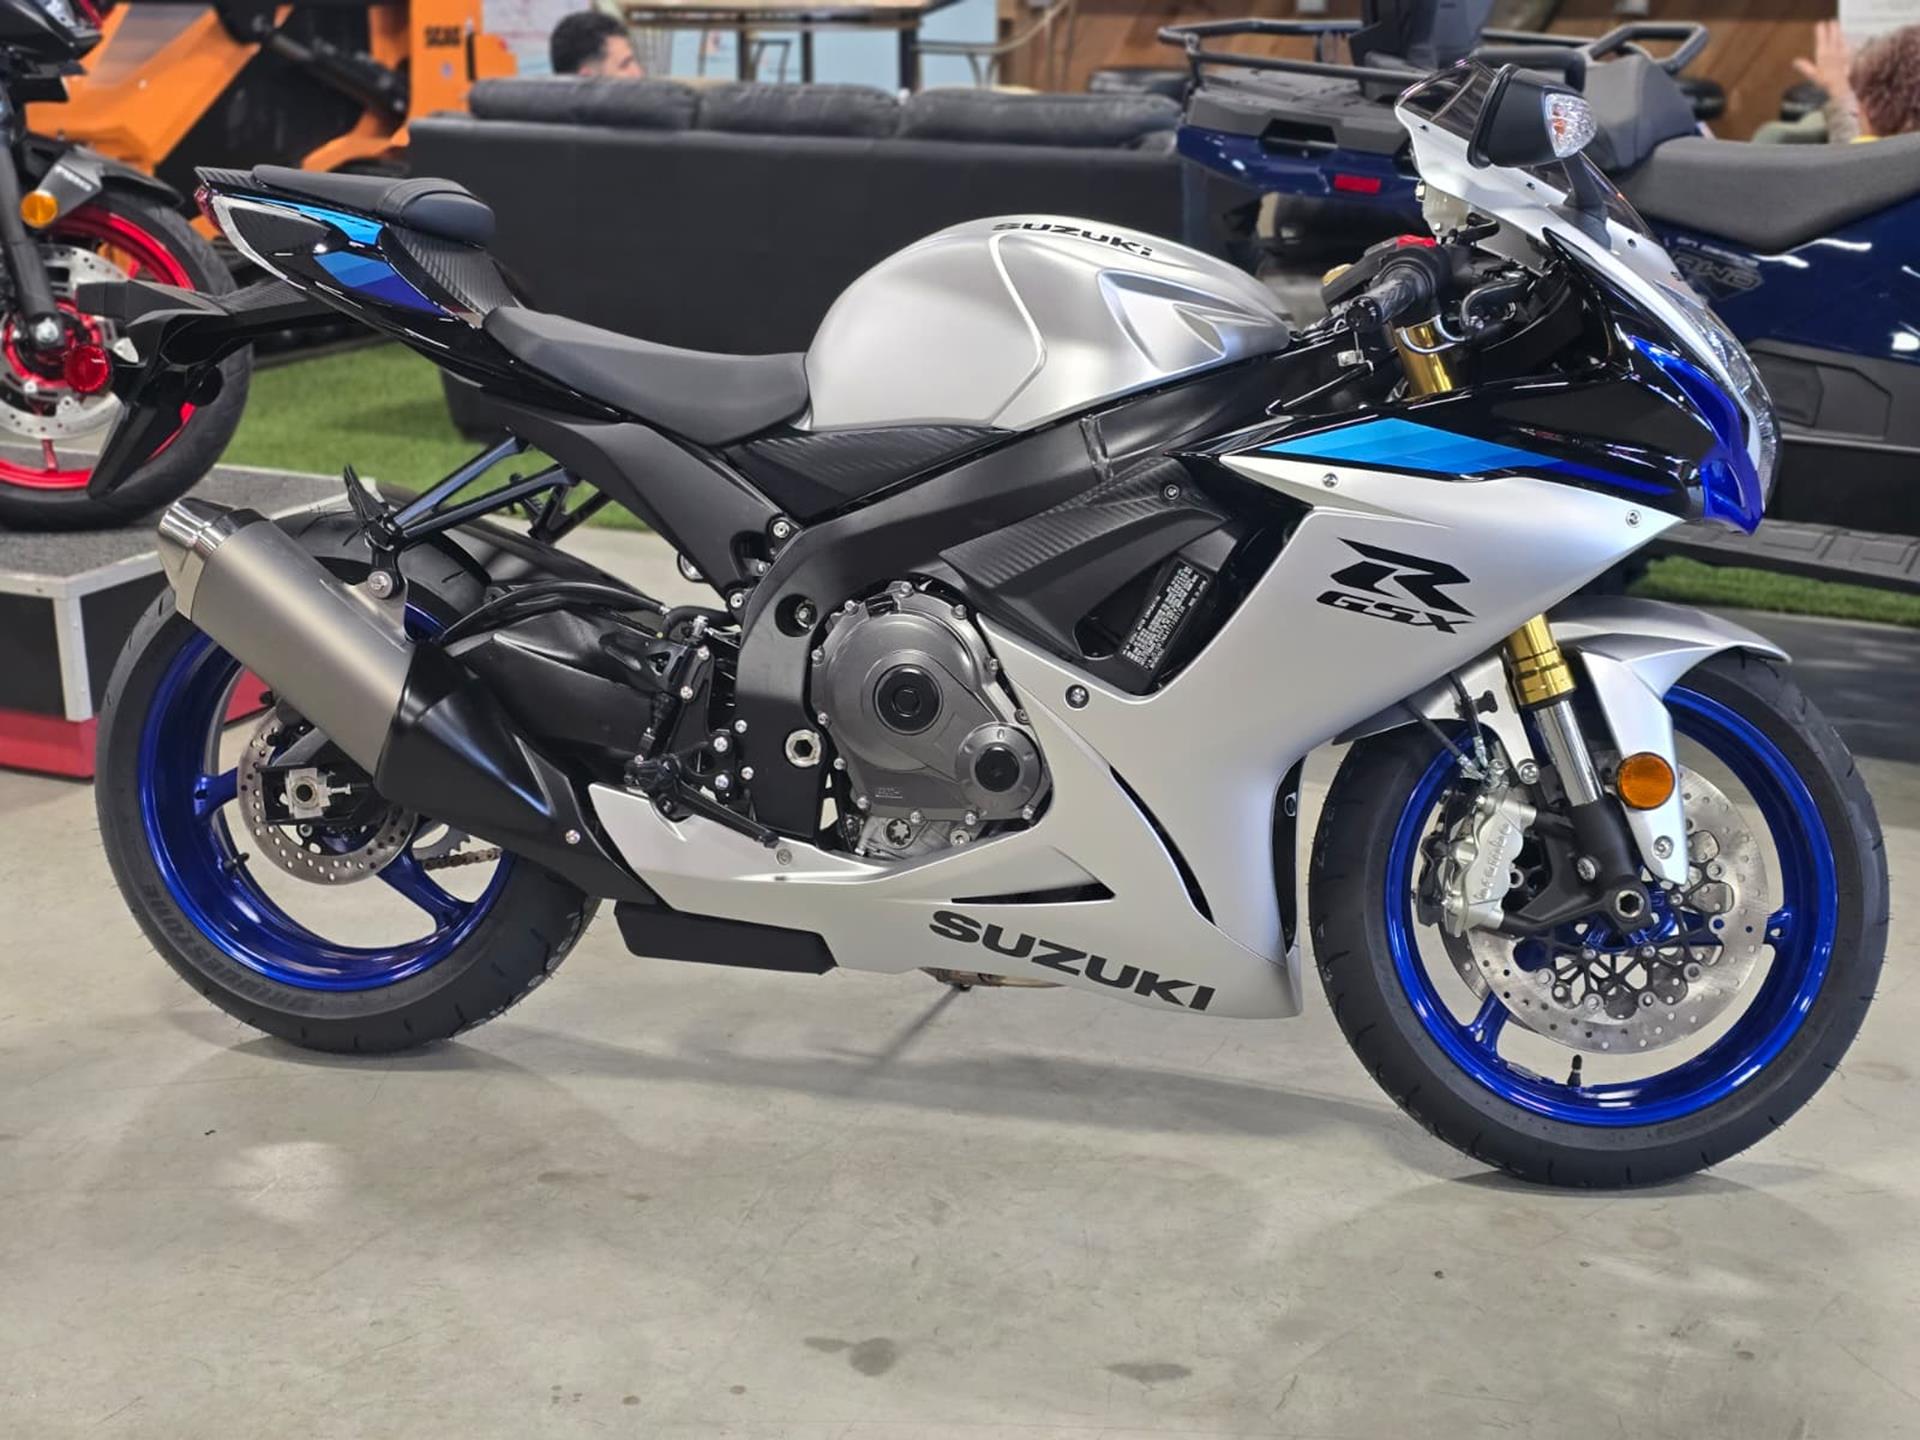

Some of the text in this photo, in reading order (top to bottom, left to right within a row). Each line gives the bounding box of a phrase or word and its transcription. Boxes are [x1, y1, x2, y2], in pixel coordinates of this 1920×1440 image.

[991, 222, 1153, 257] SUZUKI
[1329, 536, 1477, 618] R
[1315, 590, 1476, 634] GSX
[928, 909, 1216, 1011] SUZUKI
